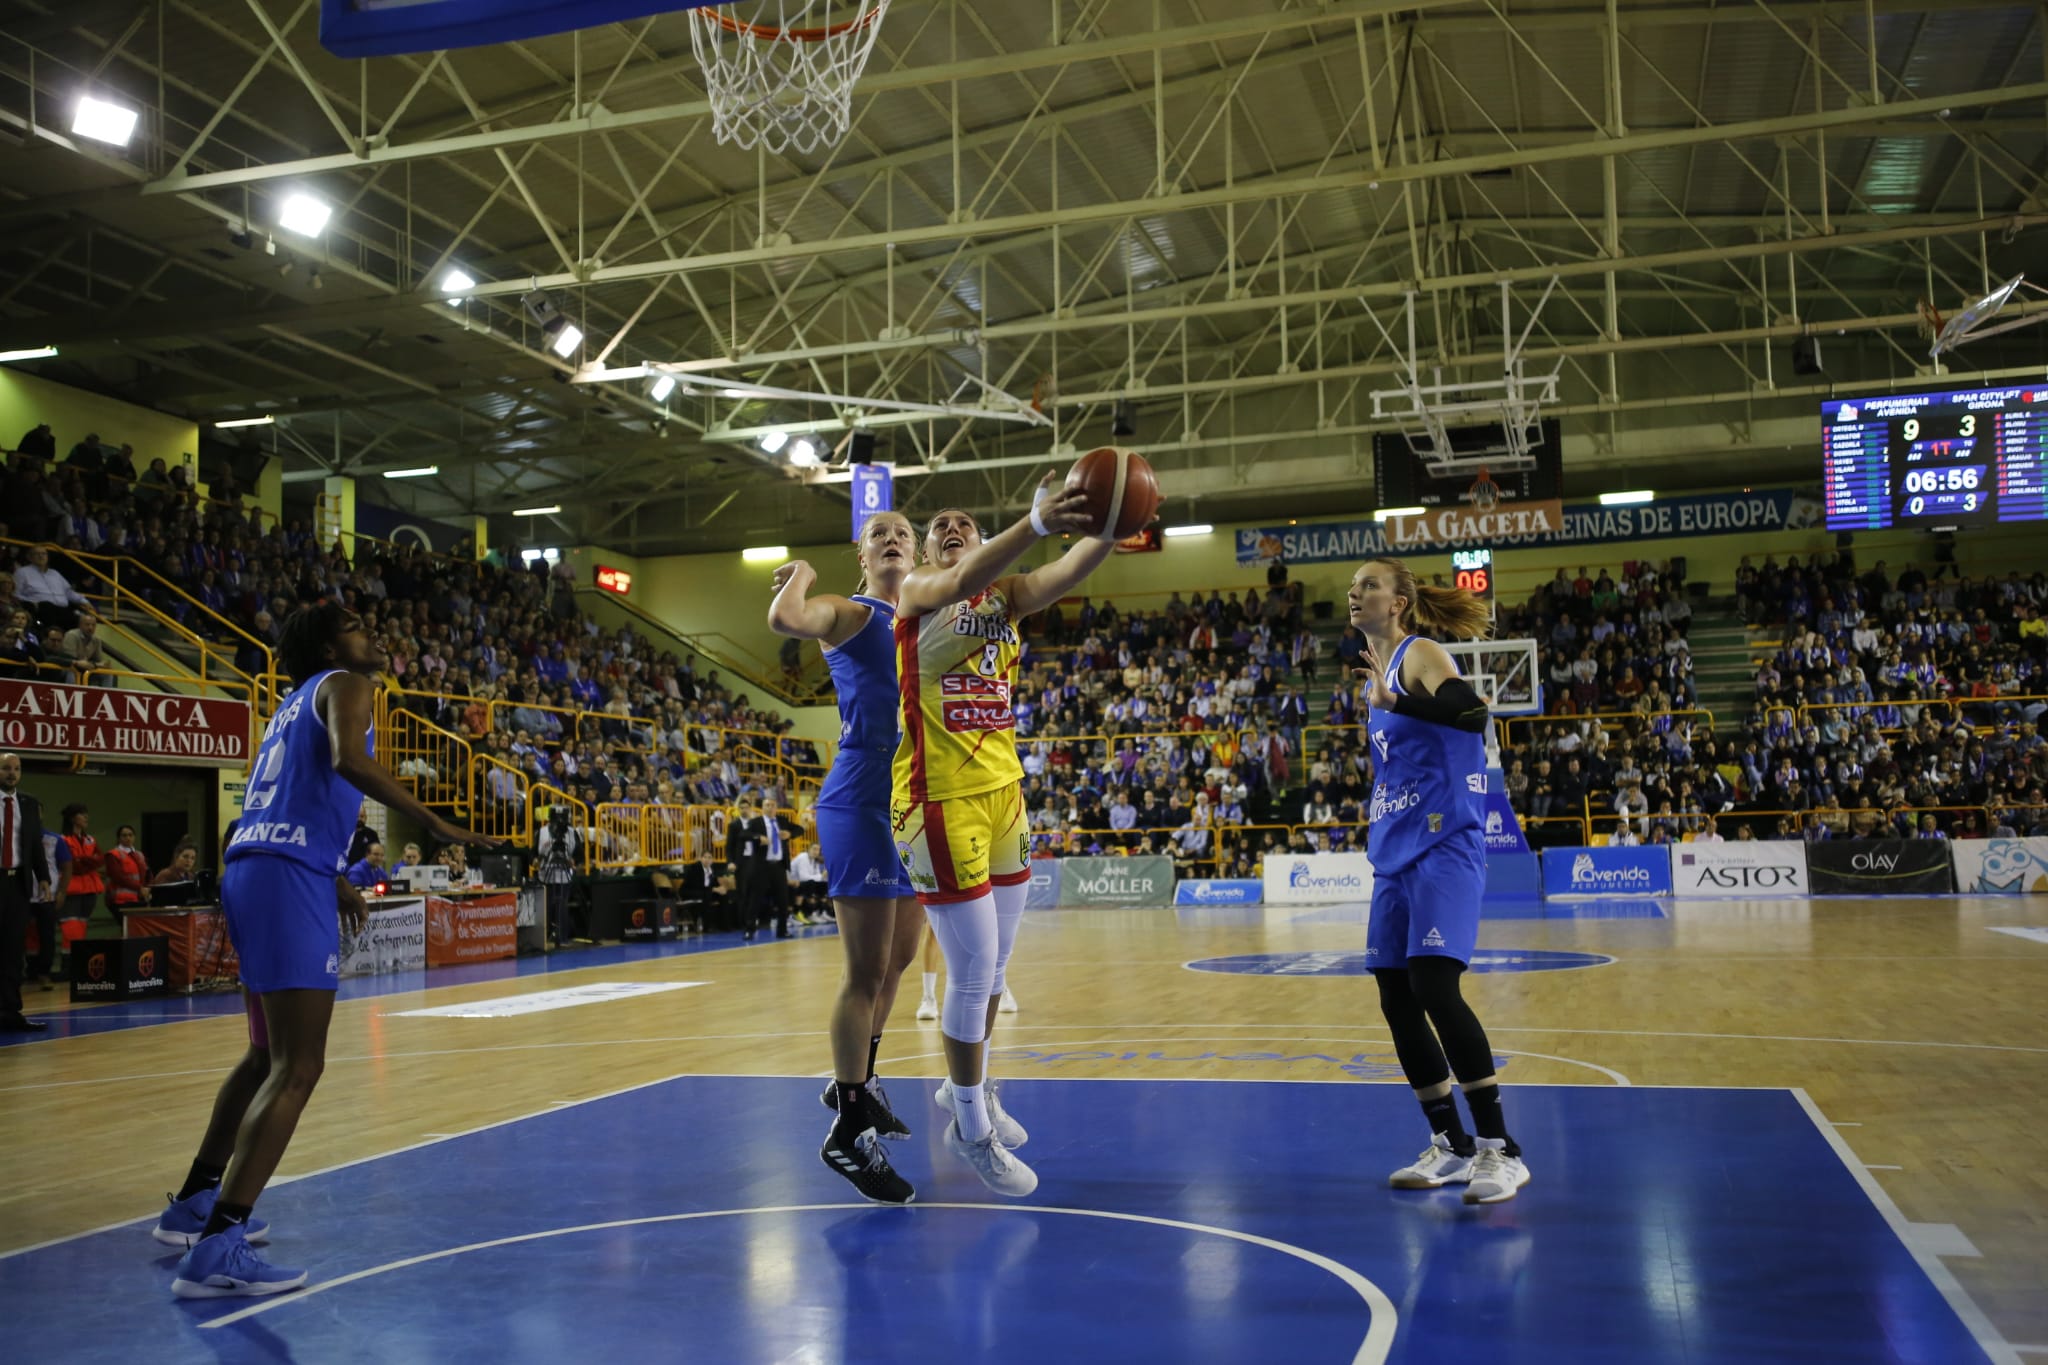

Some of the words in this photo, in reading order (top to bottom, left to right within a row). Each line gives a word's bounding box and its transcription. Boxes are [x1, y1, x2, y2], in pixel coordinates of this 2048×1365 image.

[1952, 393, 1978, 403] SPAR
[1980, 389, 2021, 401] CITYLIFT
[1967, 400, 2005, 410] GIRONA
[1877, 407, 1917, 418] AVENIDA
[1904, 419, 1919, 440] 9
[1959, 415, 1976, 436] 3
[1906, 468, 1978, 493] 06:56
[864, 481, 879, 509] 8
[1910, 497, 1924, 515] 0
[1963, 493, 1977, 511] 3
[1395, 515, 1433, 543] LA
[1437, 509, 1551, 540] GACETA
[1547, 505, 1633, 542] EINAS
[1640, 507, 1672, 535] DE
[1679, 499, 1781, 532] EUROPA
[1457, 569, 1488, 592] 06
[978, 643, 999, 676] 8
[35, 721, 69, 747] DE
[78, 725, 107, 750] LA
[114, 727, 242, 756] HUMANIDAD
[1102, 867, 1128, 876] ANNE
[1296, 874, 1361, 888] avenida
[1580, 865, 1650, 882] avenida
[1696, 866, 1799, 887] ASTOR
[1078, 877, 1154, 894] MÖLLER
[458, 923, 470, 939] de
[470, 922, 515, 939] Salamanca
[1422, 938, 1445, 947] PEAK
